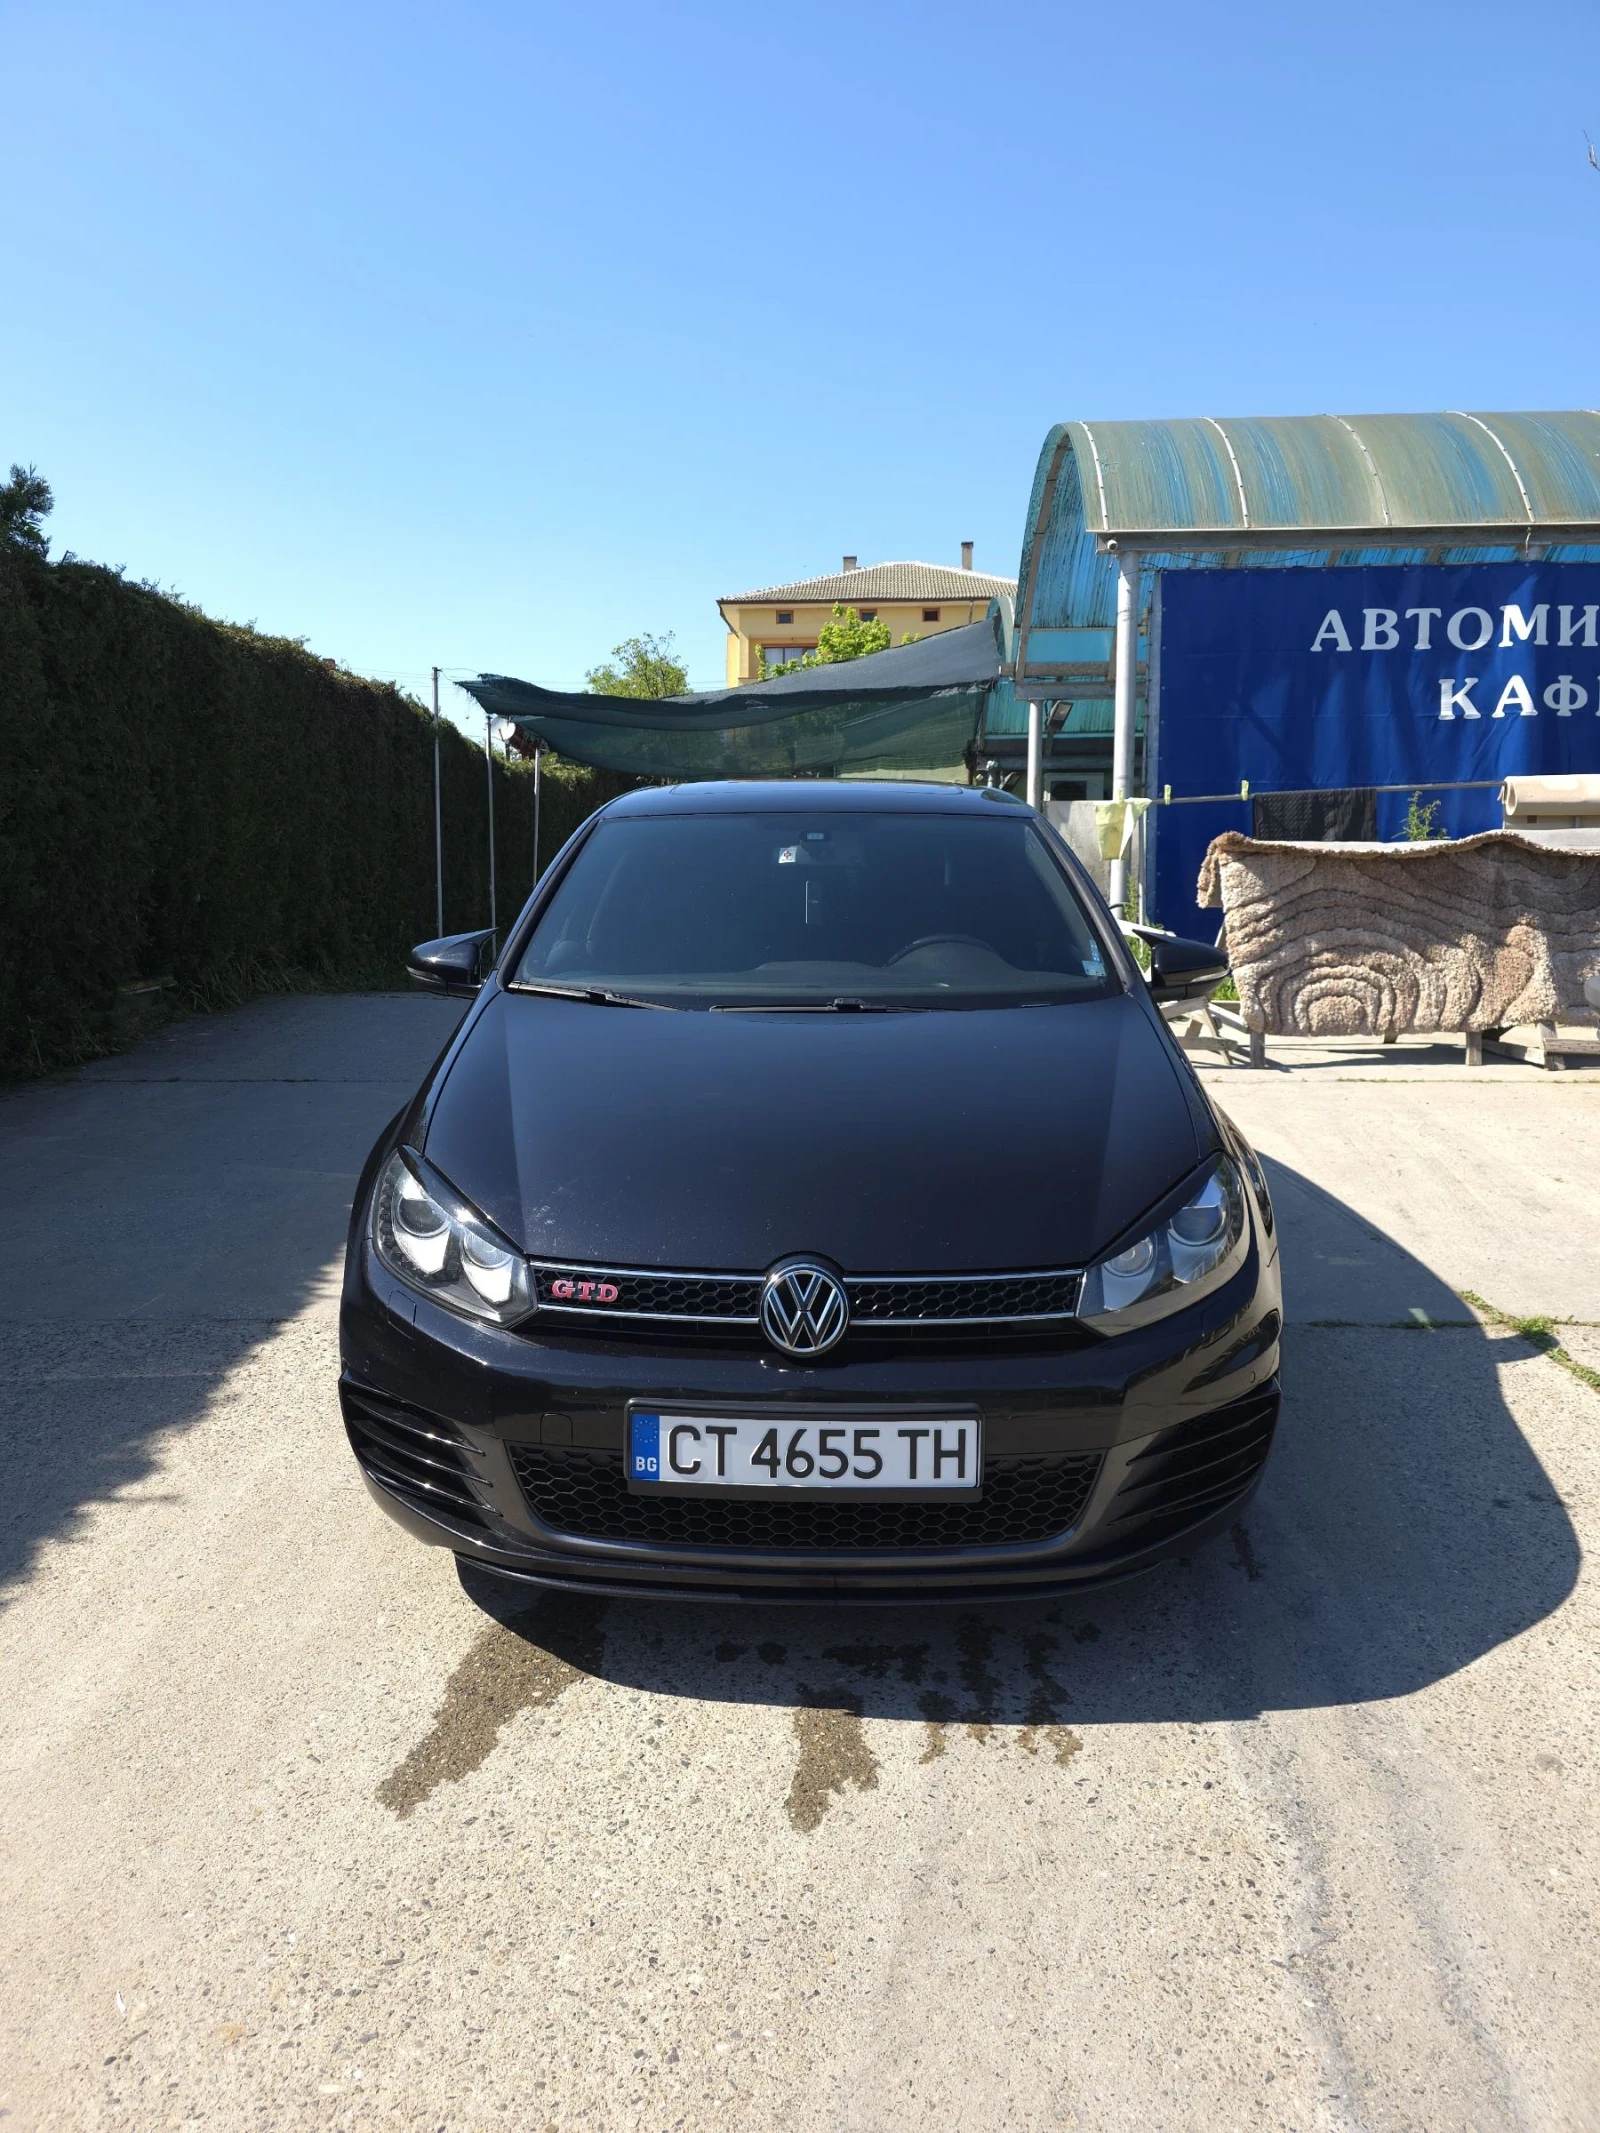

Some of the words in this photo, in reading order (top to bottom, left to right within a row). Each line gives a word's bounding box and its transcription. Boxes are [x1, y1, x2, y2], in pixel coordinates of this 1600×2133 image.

[1310, 603, 1600, 652] АВТОМИ
[1438, 674, 1600, 720] КАФ
[551, 1279, 619, 1303] GTD
[635, 1457, 658, 1472] BG
[667, 1424, 738, 1477] CT
[749, 1427, 884, 1480] 4655
[897, 1428, 967, 1480] TH
